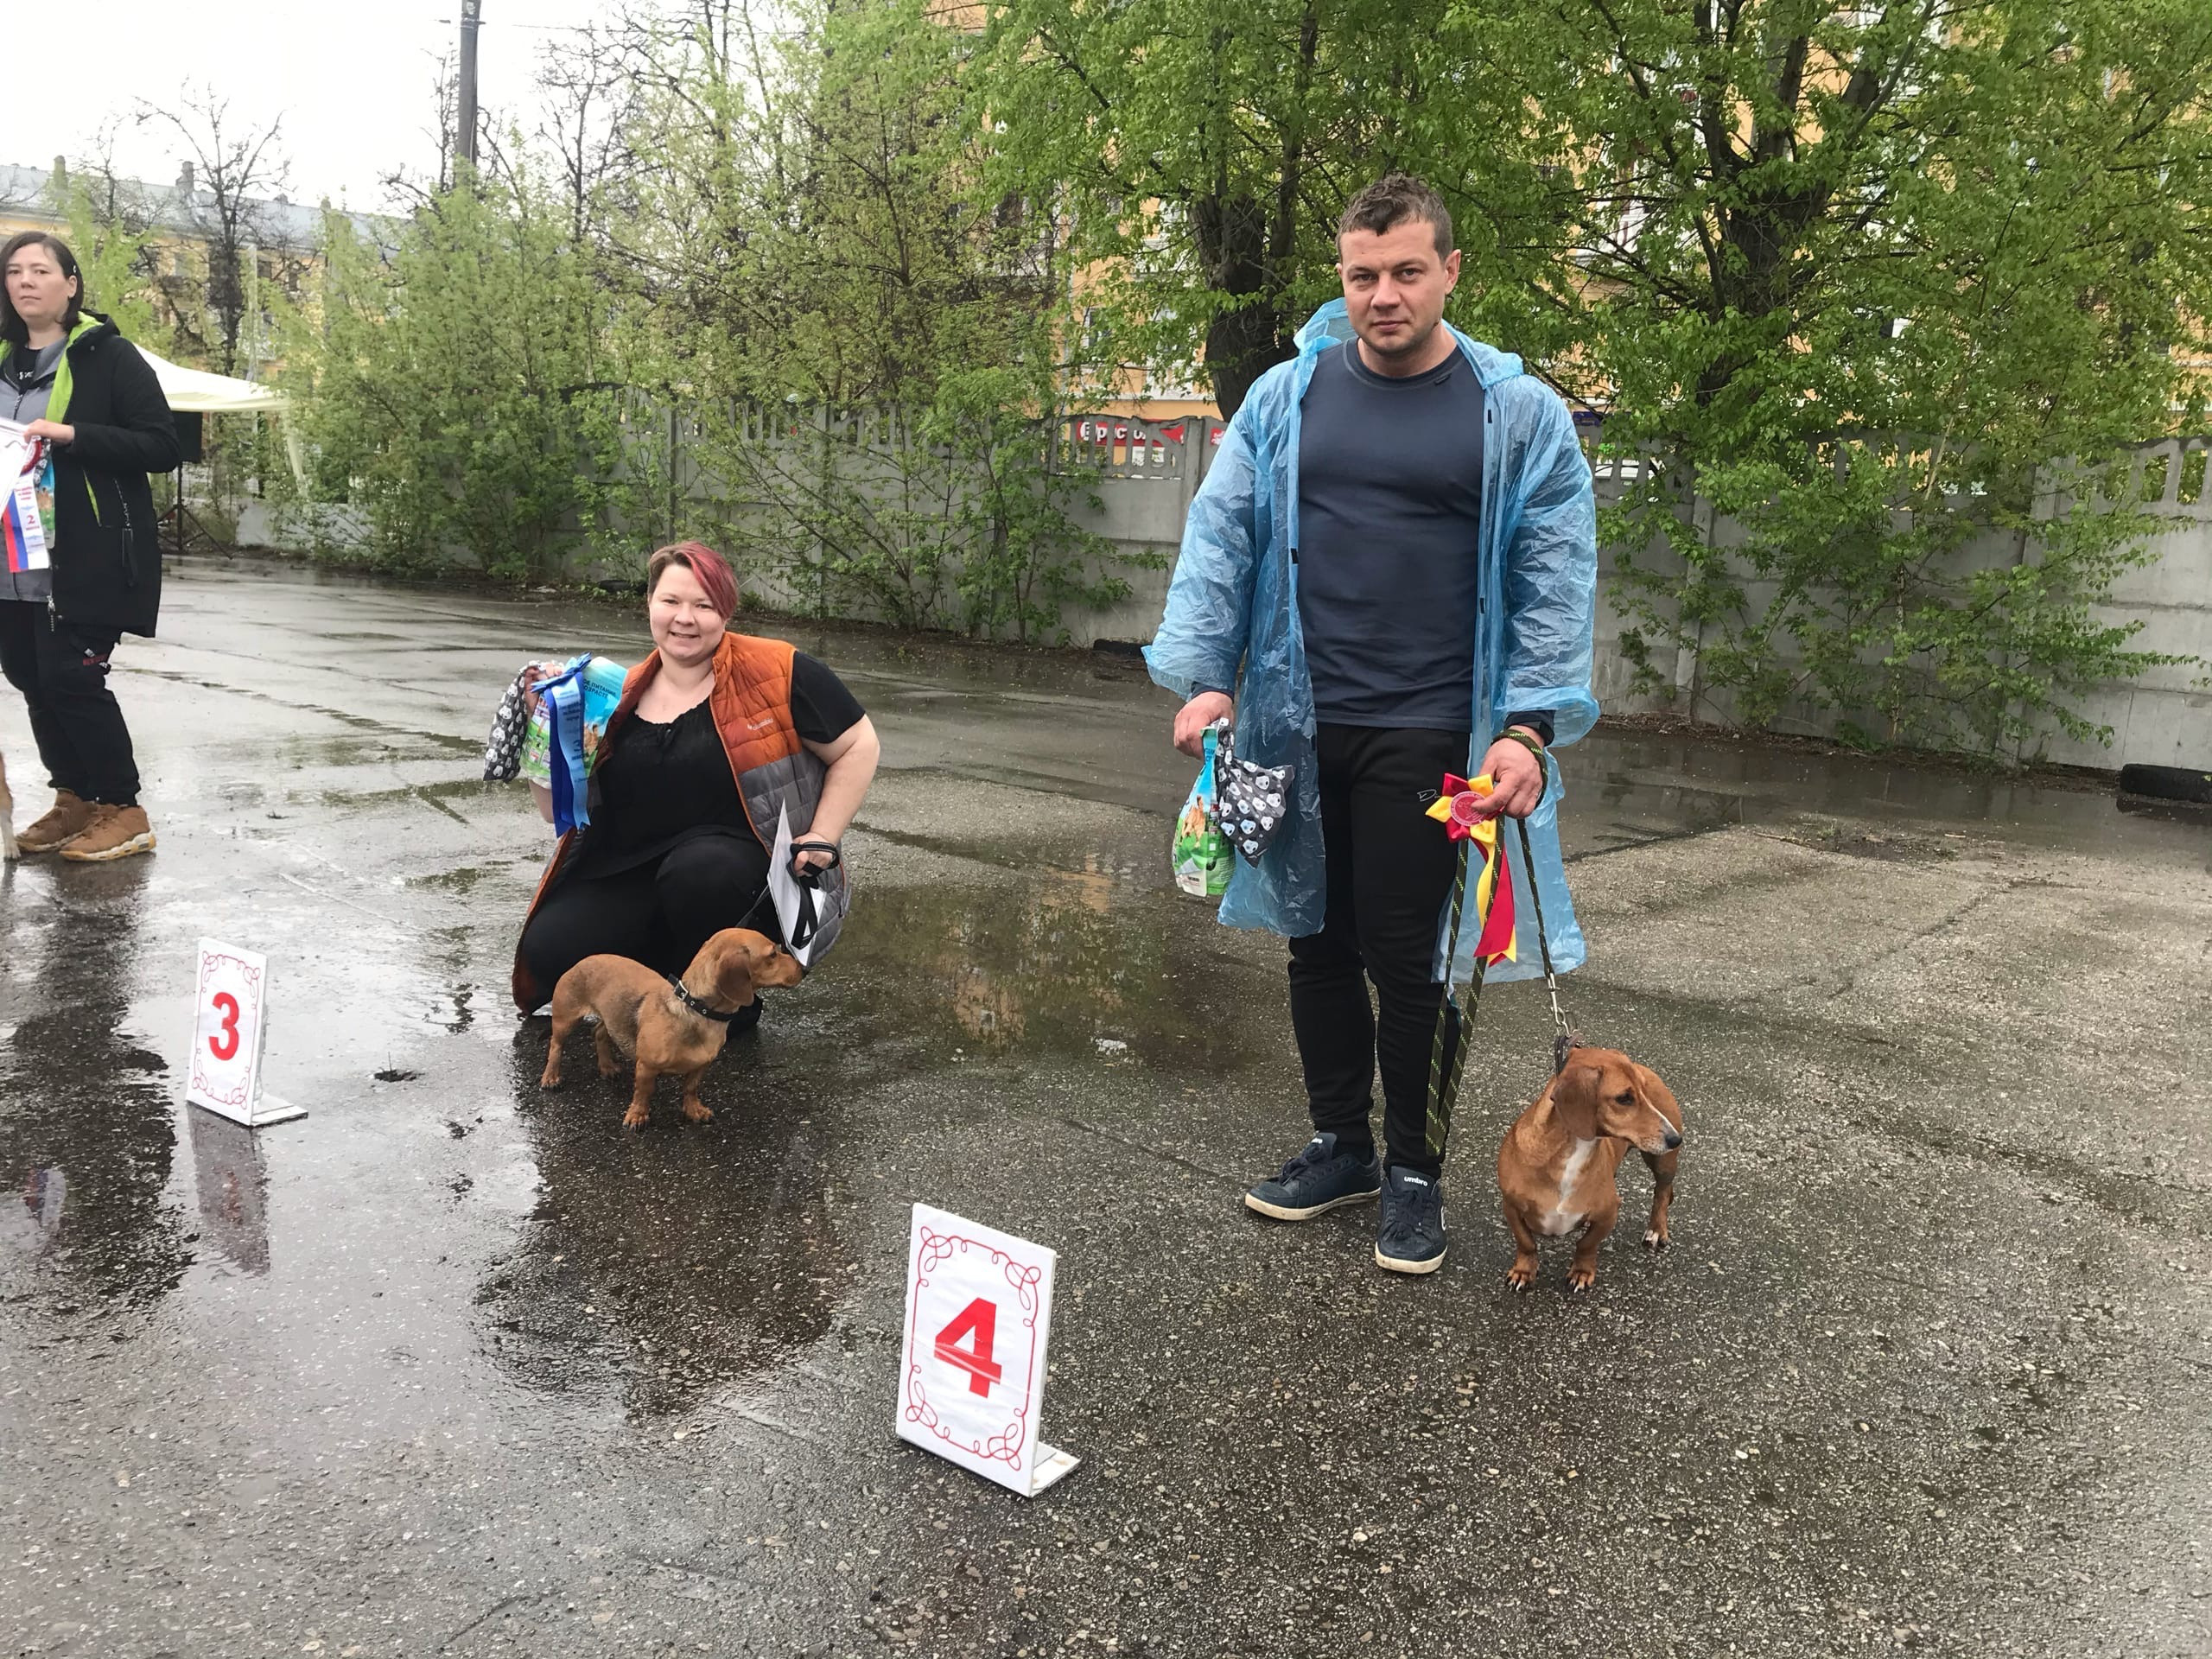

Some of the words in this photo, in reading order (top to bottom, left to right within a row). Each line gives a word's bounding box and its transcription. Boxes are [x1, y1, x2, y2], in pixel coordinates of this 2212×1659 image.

[27, 514, 35, 524] 2
[208, 991, 239, 1061] 3
[1404, 1175, 1427, 1186] umbro
[933, 1297, 1002, 1399] 4
